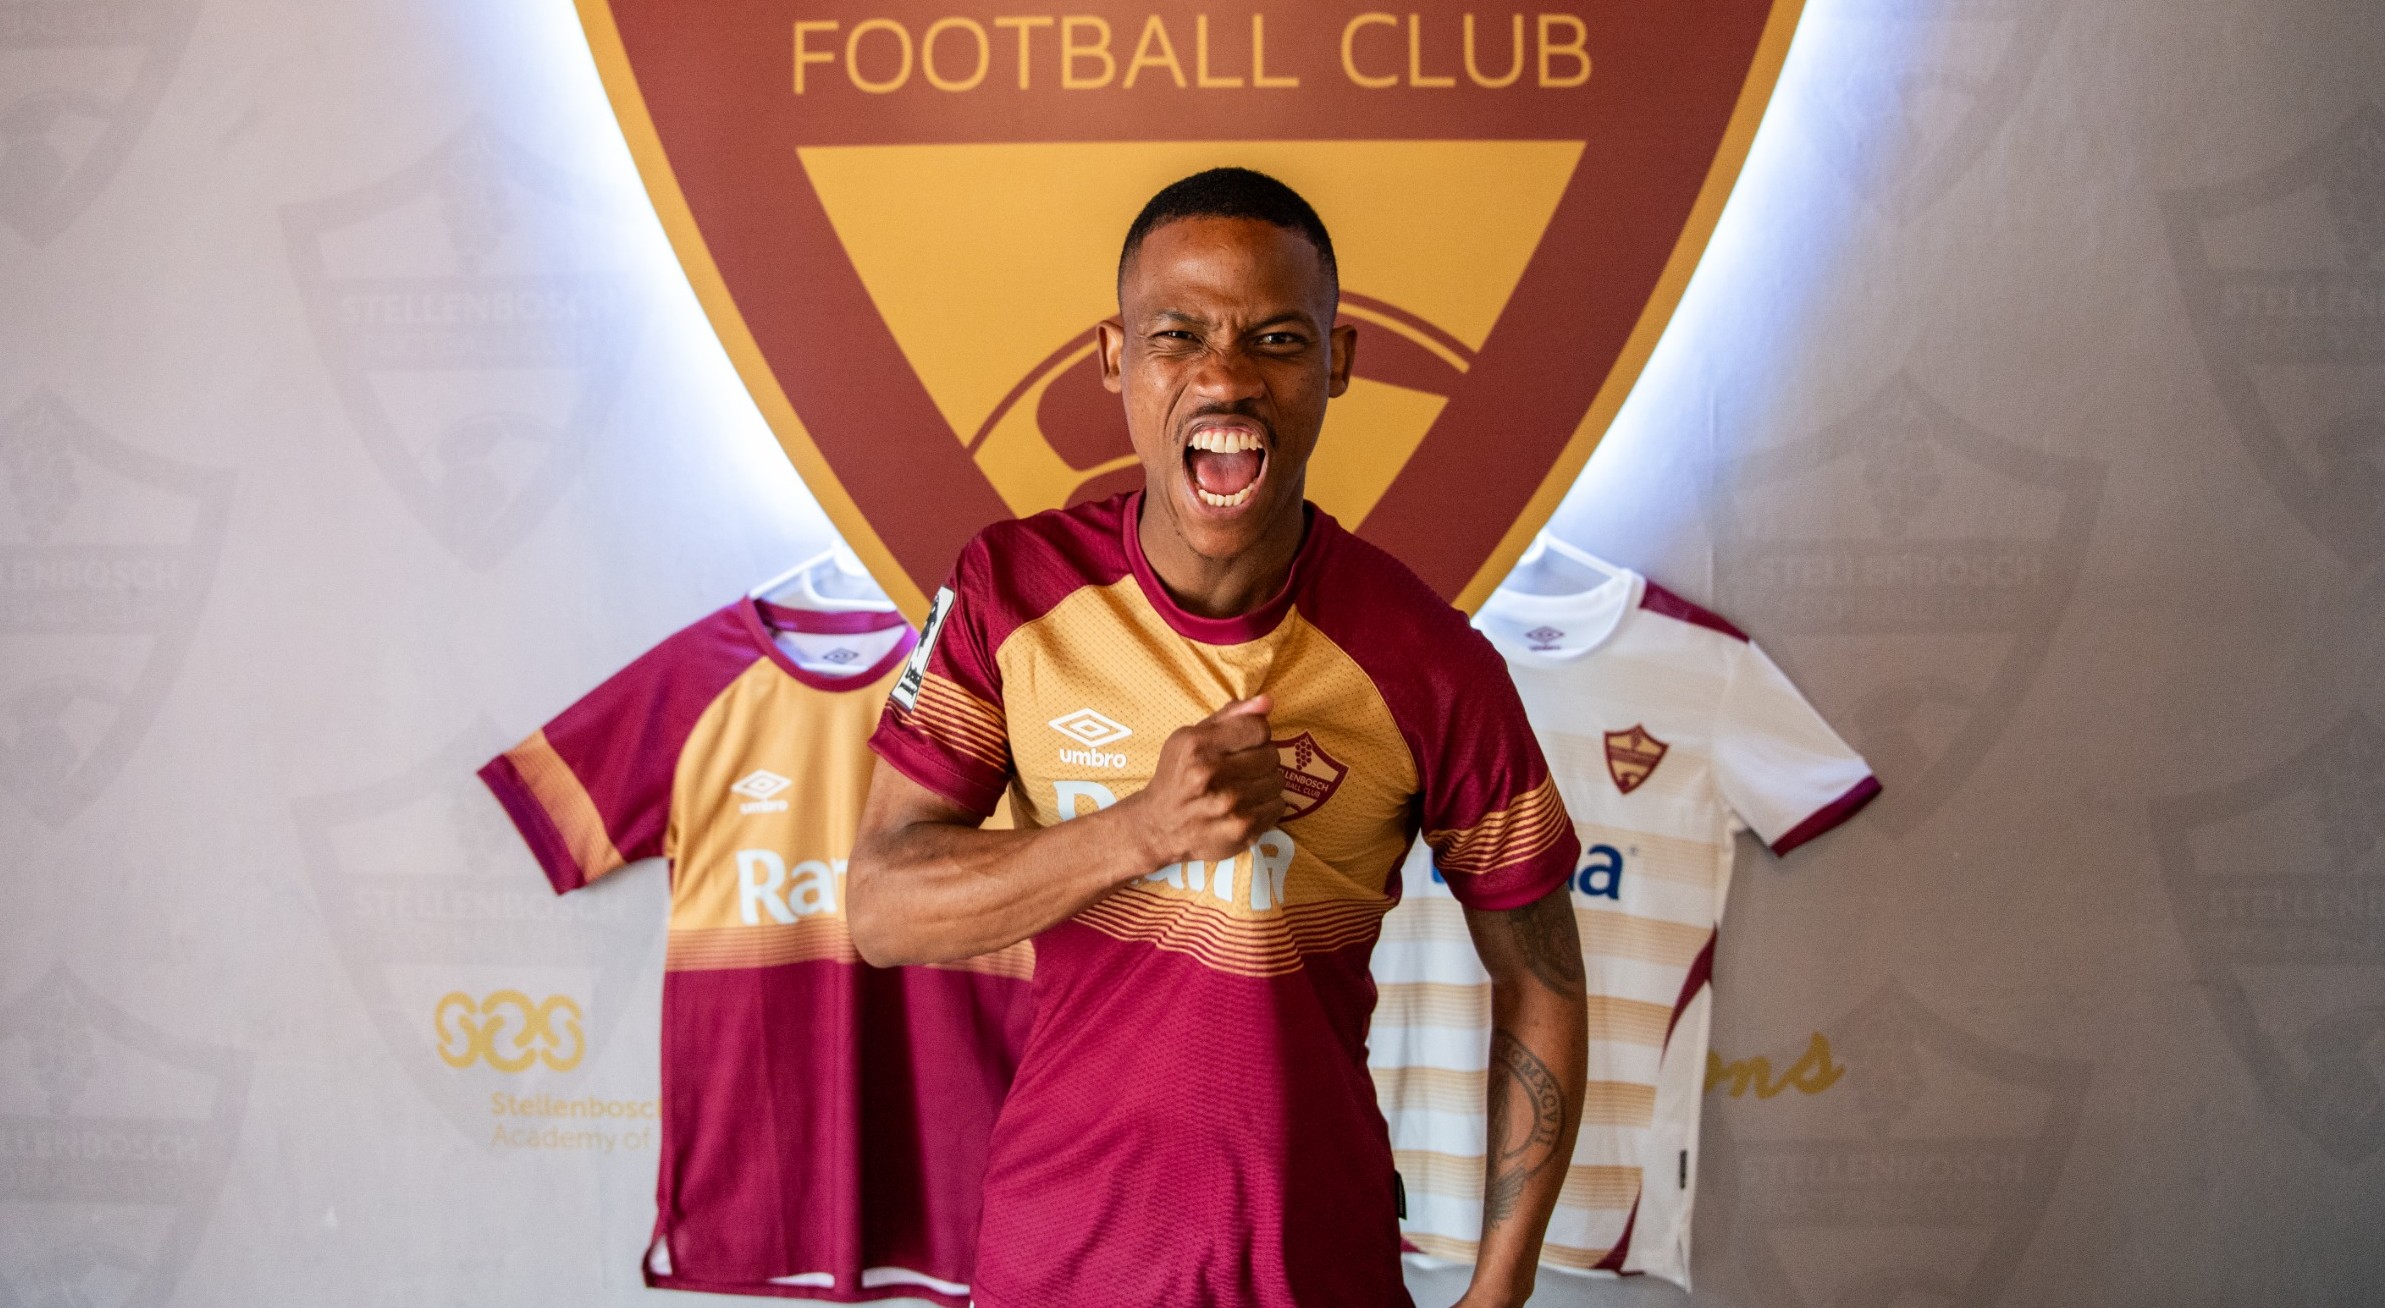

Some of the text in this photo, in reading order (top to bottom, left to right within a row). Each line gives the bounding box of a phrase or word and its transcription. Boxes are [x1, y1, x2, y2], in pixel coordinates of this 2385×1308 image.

[793, 12, 1592, 94] FOOTBALL CLUB
[1059, 748, 1127, 769] umbro
[1284, 781, 1321, 798] BALL CLUB
[490, 1124, 652, 1154] Academy of
